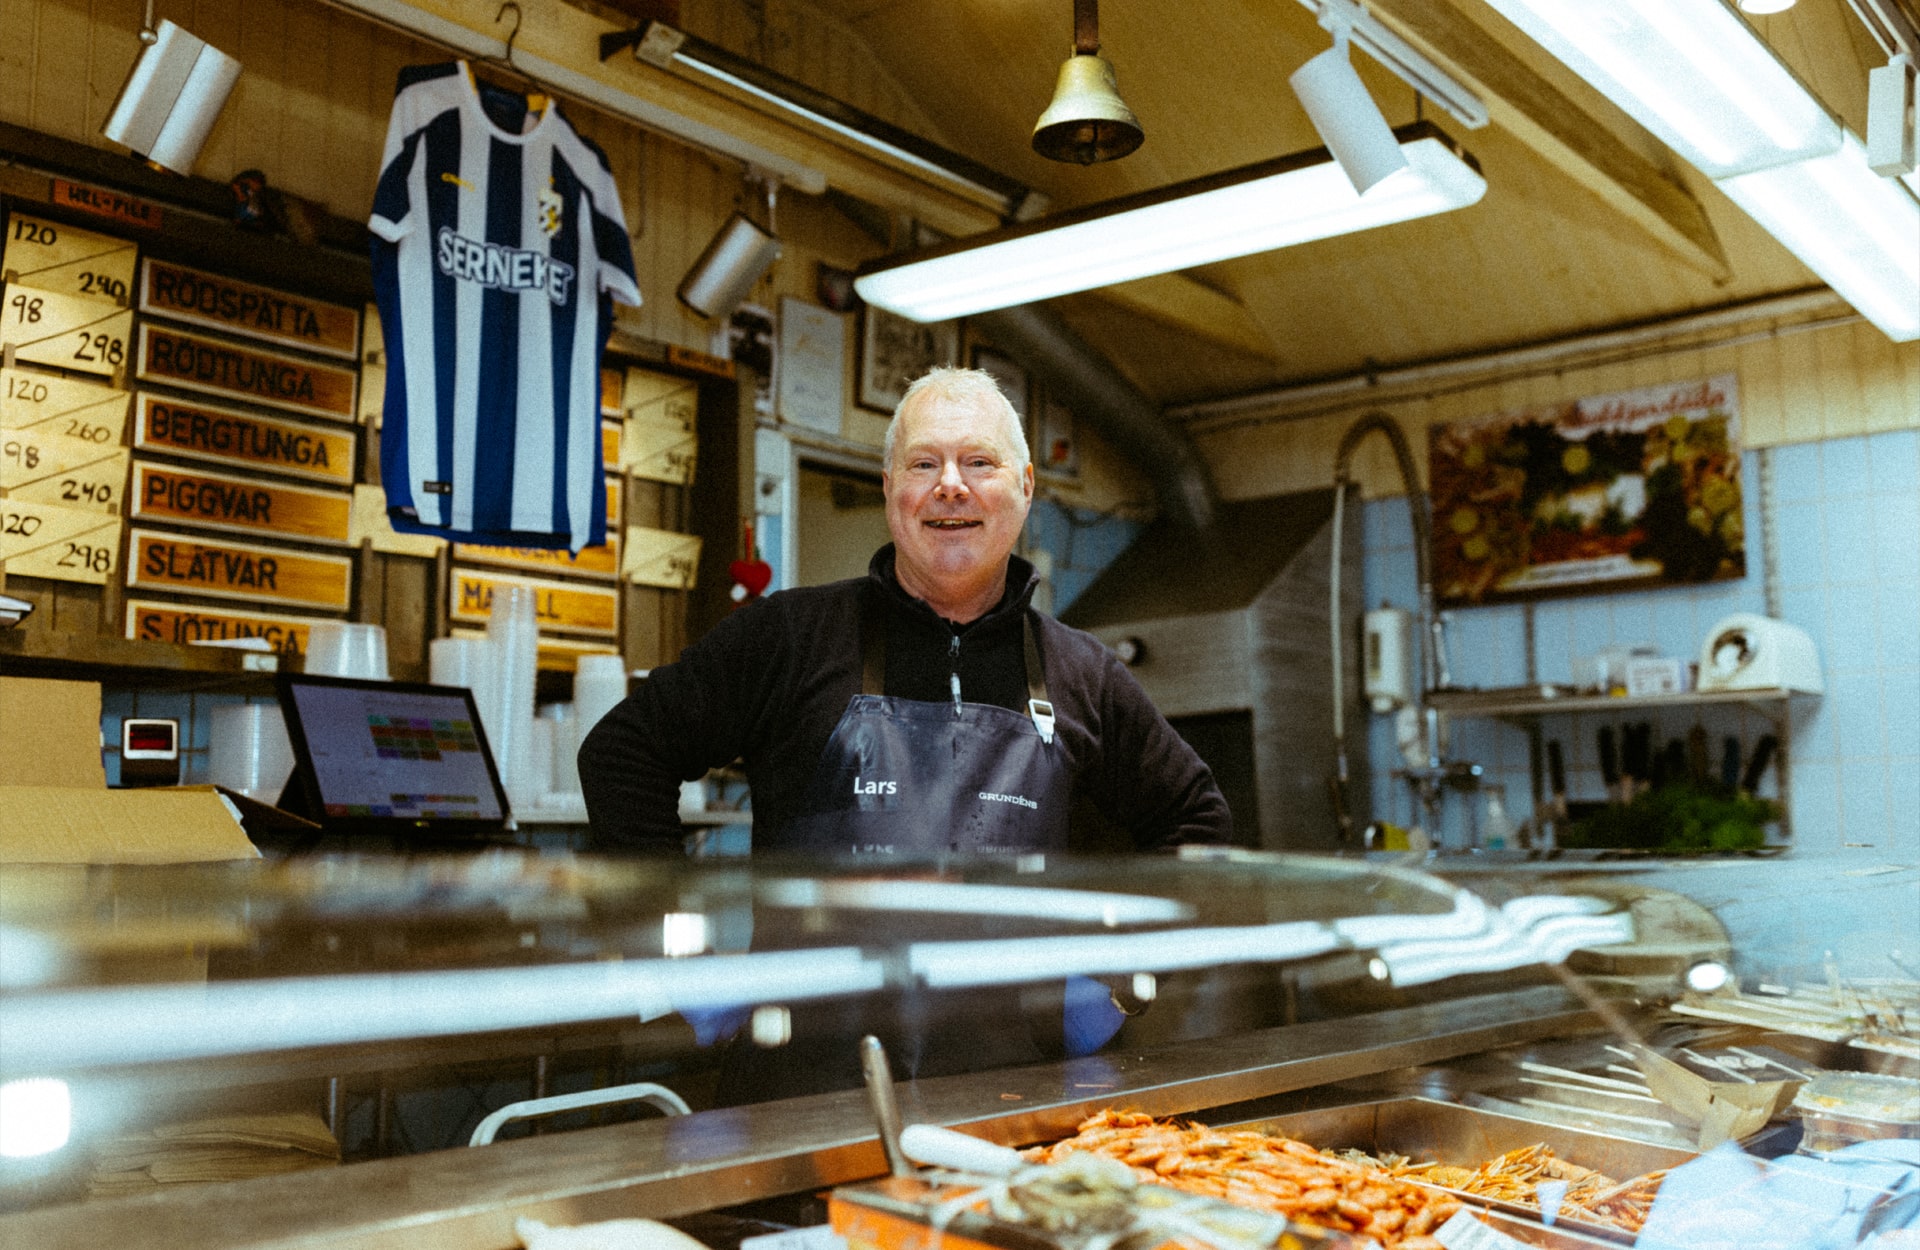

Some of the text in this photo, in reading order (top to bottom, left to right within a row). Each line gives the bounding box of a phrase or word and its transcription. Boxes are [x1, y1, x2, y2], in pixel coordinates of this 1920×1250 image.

[14, 220, 57, 246] 120
[438, 228, 570, 303] SERNEKE
[78, 272, 126, 299] 240
[12, 295, 44, 324] 98
[155, 270, 321, 338] RÖDSPÄTTA
[73, 332, 124, 365] 298
[152, 336, 314, 400] RÖDTUNGA
[6, 376, 48, 403] 120
[65, 419, 111, 444] 260
[151, 405, 330, 468] BERGTUNGA
[4, 441, 40, 469] 98
[61, 479, 112, 503] 240
[146, 475, 272, 523] PIGGVAR
[57, 543, 111, 573] 298
[145, 545, 278, 590] SLÄTVAR
[854, 777, 897, 795] Lars
